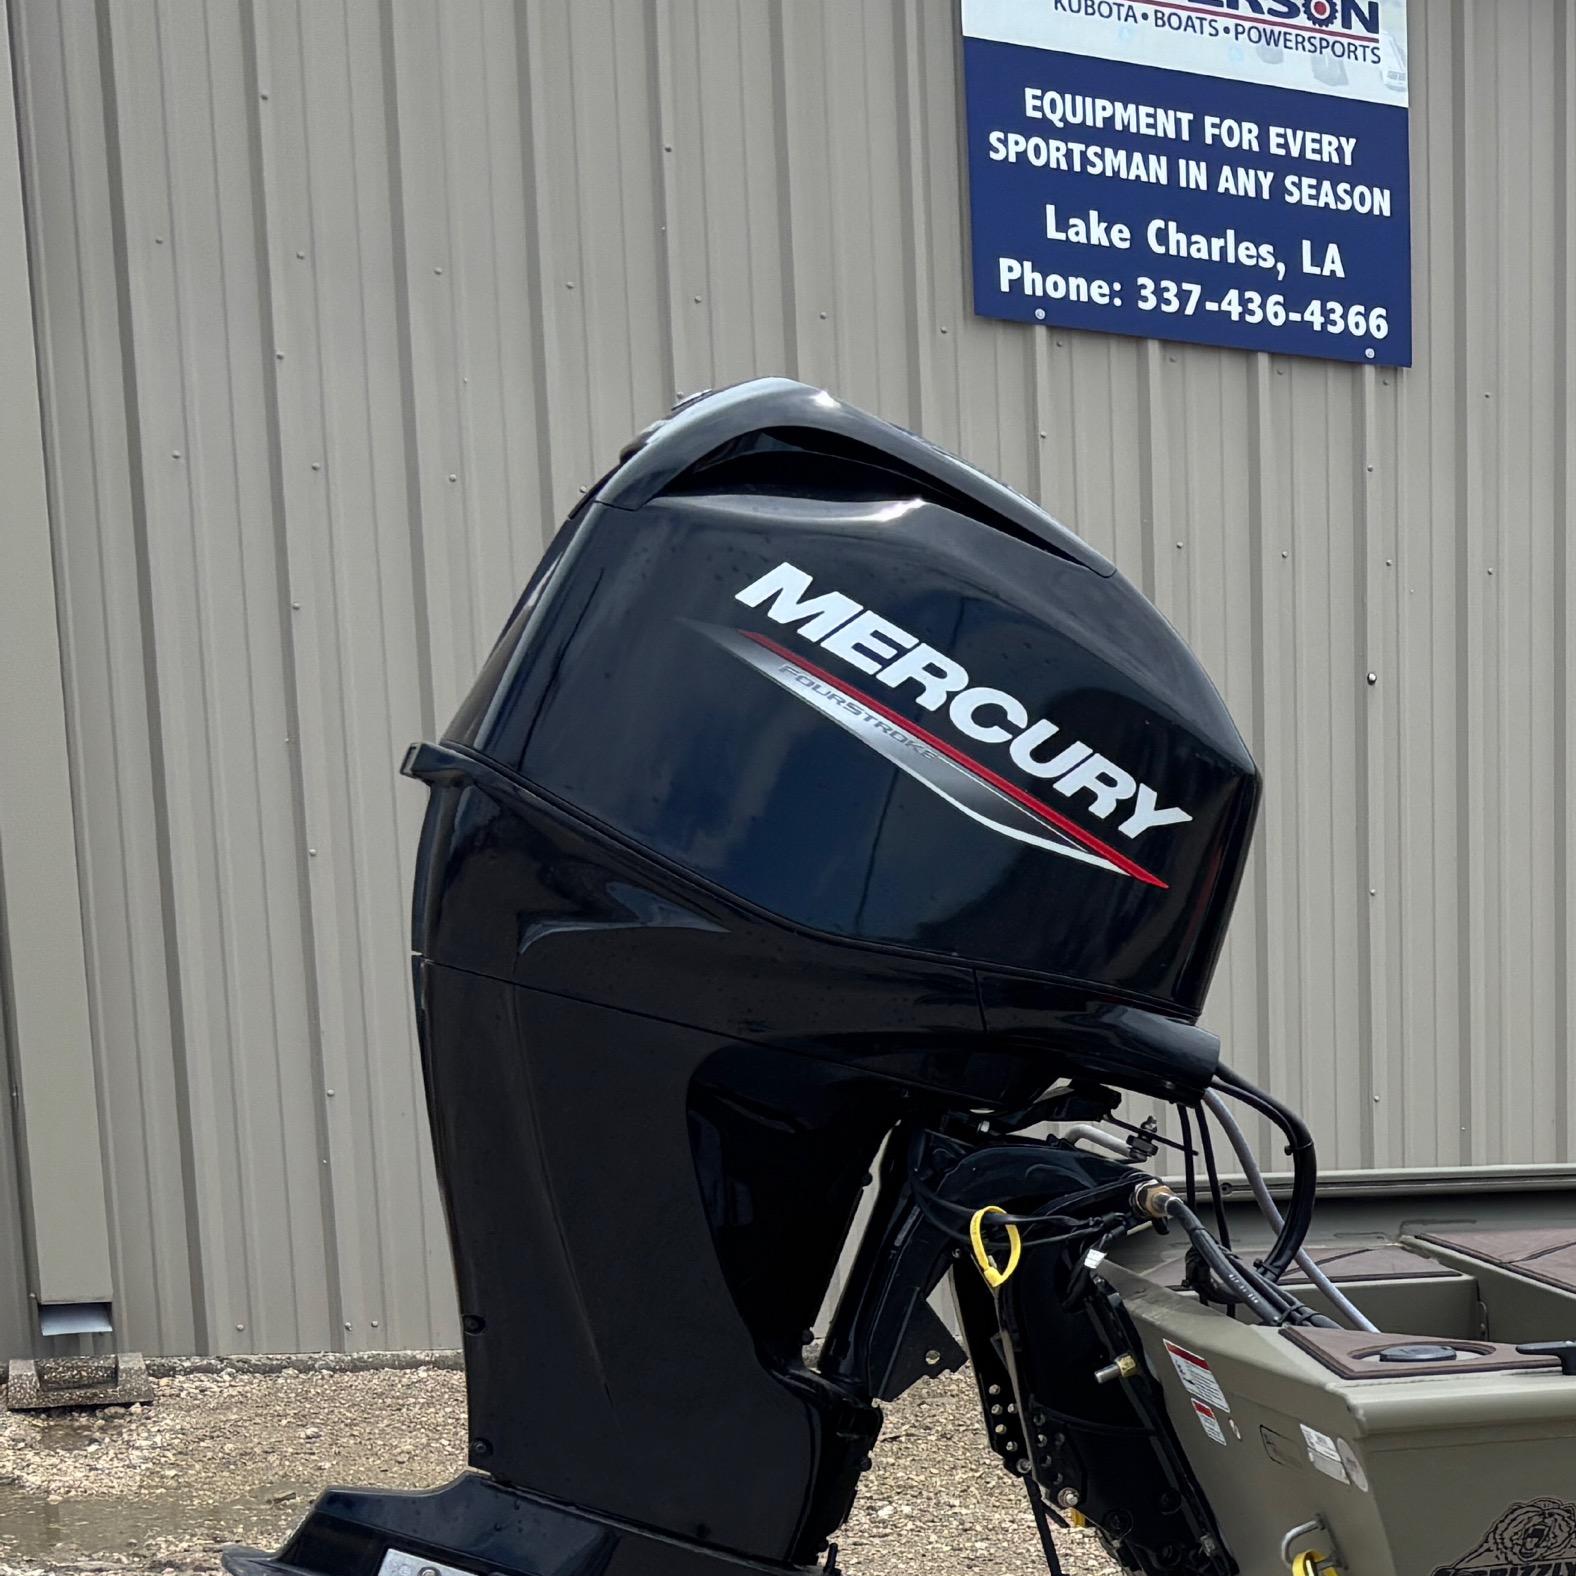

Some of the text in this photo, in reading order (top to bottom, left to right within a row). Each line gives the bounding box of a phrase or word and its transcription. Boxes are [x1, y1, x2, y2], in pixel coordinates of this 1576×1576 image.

[1054, 0, 1381, 65] KUBOTA BOATS POWERSPORTS
[1024, 87, 1357, 166] EQUIPMENT FOR EVERY
[988, 130, 1391, 217] SPORTSMAN IN ANY SEASON
[1045, 203, 1345, 281] Lake Charles, LA
[998, 257, 1389, 339] Phone: 337-436-4366
[735, 562, 1193, 839] MERCURY
[778, 663, 938, 760] FOURSTROKE
